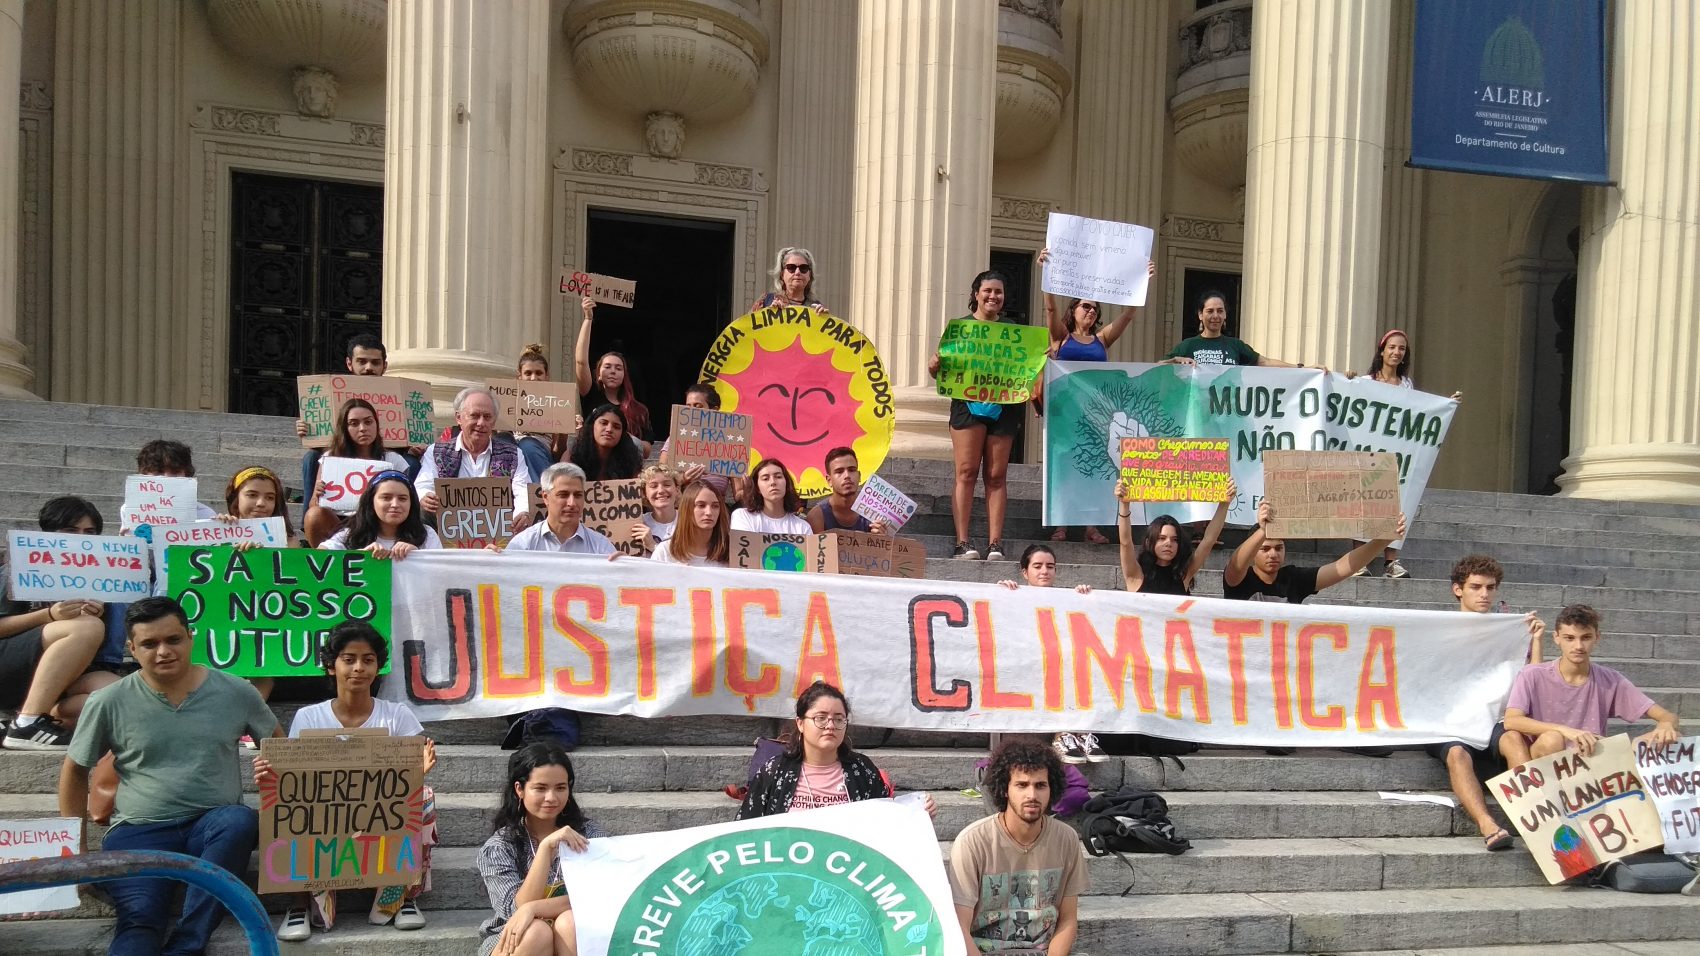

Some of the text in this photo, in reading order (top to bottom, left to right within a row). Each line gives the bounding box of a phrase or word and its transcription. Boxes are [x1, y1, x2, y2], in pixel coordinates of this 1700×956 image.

[1481, 86, 1543, 107] ALERJ
[1475, 111, 1548, 125] ASSEMBLEIA LEGISLATIVA
[1514, 123, 1539, 132] JANEIRO
[1455, 134, 1565, 155] Departamento de Cultura
[1082, 217, 1111, 235] POVO
[560, 275, 634, 304] LOVE IS IN THE AIR
[1000, 327, 1022, 343] AS
[701, 307, 893, 419] NERGIA LIMPA PARA TODOS
[331, 376, 346, 389] O
[955, 372, 965, 384] A
[332, 391, 402, 405] TEMPORAL
[488, 385, 527, 397] MUDE A
[939, 385, 1029, 402] DO COLAPS
[300, 396, 330, 411] GREVE
[1208, 384, 1286, 418] MUDE
[1300, 387, 1320, 418] O
[304, 408, 332, 422] PELO
[376, 409, 401, 422] FOI
[412, 410, 427, 420] FOR
[507, 407, 544, 417] E NÃO
[680, 407, 747, 430] SEM TEMPO
[307, 421, 335, 437] LIMA
[516, 418, 562, 428] O CLIMA
[380, 428, 408, 441] ASO
[408, 431, 435, 445] BRASIL
[701, 427, 726, 442] PRA
[1237, 424, 1296, 462] NÃO
[1122, 439, 1155, 451] COMO
[1121, 449, 1227, 461] ponto DE ACREDITAR
[1122, 458, 1139, 468] QUE
[710, 459, 747, 477] IRMÃO
[1121, 467, 1191, 480] QUE AQUECEM E
[139, 480, 164, 493] NÃO
[584, 481, 643, 504] CÊS NÃO
[1121, 477, 1129, 486] A
[1131, 478, 1152, 488] VIDA
[1155, 478, 1168, 487] NO
[1171, 479, 1213, 490] PLANETA
[159, 495, 176, 507] HÁ
[440, 484, 488, 508] JUNTOS
[491, 484, 510, 508] EM
[864, 486, 903, 515] QUEIMAR
[869, 475, 908, 511] PAREM DE
[1143, 486, 1227, 502] ASSUNTO NOSSO
[139, 503, 157, 512] UM
[599, 503, 641, 521] COMO
[860, 494, 889, 514] NOSSO
[130, 514, 178, 525] PLANETA
[441, 508, 513, 539] GREVE
[856, 503, 893, 526] FUTURO
[165, 522, 274, 543] QUEREMOS !
[762, 533, 805, 545] NOSSO
[17, 536, 142, 555] ELEVE O NIVEL
[837, 535, 909, 553] EJA PARTE DA
[29, 550, 143, 570] DA SUA VOZ
[188, 548, 369, 587] SALVE
[838, 549, 890, 572] OLUÇÃO
[18, 569, 148, 593] NÃO DO OCEANO
[176, 587, 378, 624] O NOSSO
[402, 583, 1408, 732] JUSTIÇA CLIMÁTICA
[1637, 741, 1695, 768] PAREM
[279, 768, 411, 804] QUEREMOS
[1499, 765, 1545, 803] NÃO
[1642, 770, 1700, 797] VENDER
[822, 795, 849, 803] CHANG
[1520, 770, 1644, 833] UM PLANETA
[273, 801, 405, 839] POLITICAS
[0, 829, 75, 847] QUEIMAR
[706, 840, 815, 875] PELO
[825, 851, 918, 932] CLIMA
